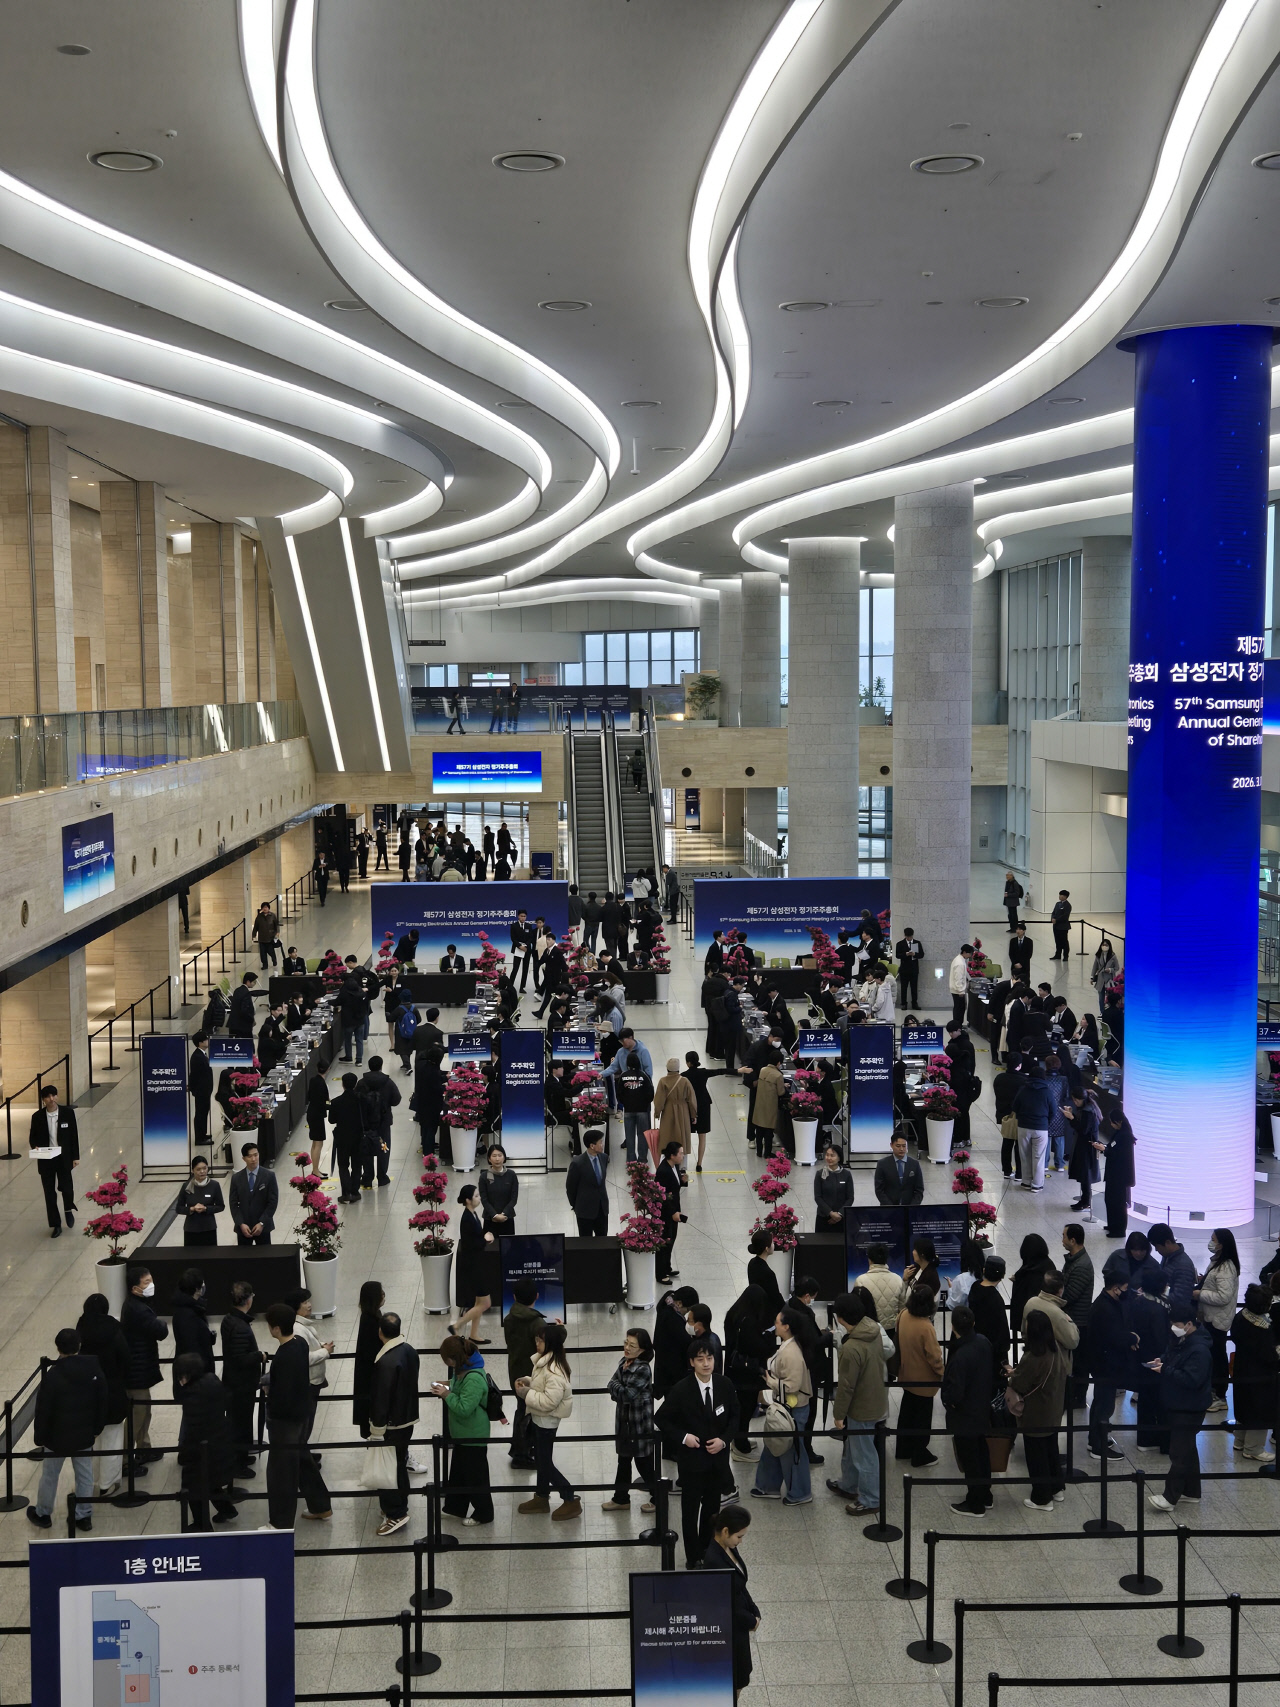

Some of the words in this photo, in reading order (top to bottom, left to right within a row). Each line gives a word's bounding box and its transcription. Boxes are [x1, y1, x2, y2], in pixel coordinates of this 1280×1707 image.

[1237, 636, 1264, 655] 제57
[1170, 662, 1245, 682] 삼성전자
[1174, 696, 1203, 710] 57th
[1205, 697, 1260, 713] Samsung
[1177, 716, 1230, 728] Annual
[1208, 733, 1225, 746] of
[423, 910, 446, 919] 제57기
[447, 910, 475, 919] 삼성전자
[476, 909, 517, 919] 정기주주총회
[746, 906, 769, 915] 제57기
[770, 906, 797, 915] 삼성전자
[799, 906, 839, 915] 정기주주총회
[908, 1031, 919, 1040] 25
[926, 1031, 937, 1040] 30
[1258, 1027, 1269, 1036] 37
[458, 1038, 464, 1046] 7
[472, 1037, 481, 1046] 12
[561, 1036, 570, 1044] 13
[577, 1036, 587, 1044] 18
[806, 1034, 815, 1042] 19
[823, 1033, 834, 1042] 24
[222, 1043, 226, 1051] 1
[234, 1043, 240, 1051] 6
[123, 1558, 148, 1575] 1층
[152, 1556, 202, 1575] 안내도
[668, 1615, 697, 1624] 신분증을
[644, 1627, 667, 1636] 제시해
[668, 1626, 690, 1635] 주시기
[691, 1625, 722, 1634] 바랍니다.
[201, 1665, 218, 1674] 주주
[218, 1663, 240, 1673] 등록석
